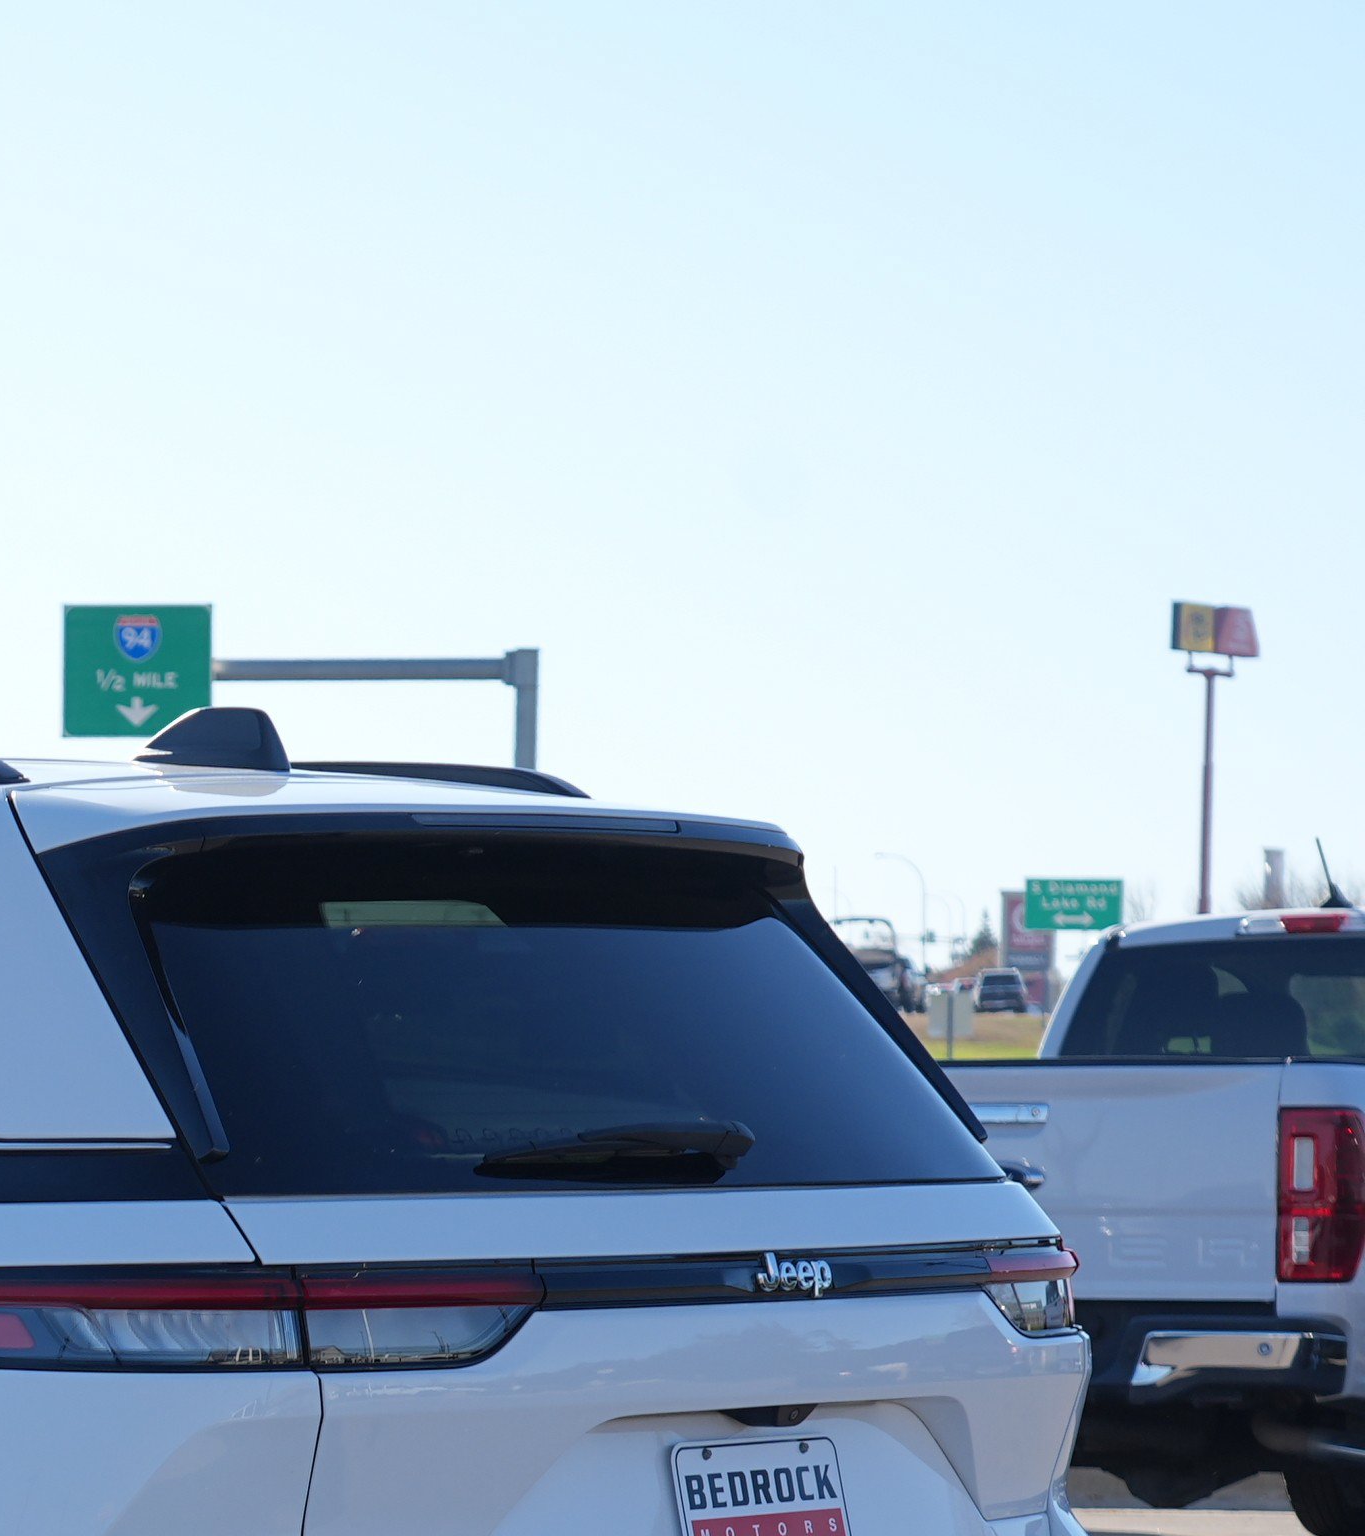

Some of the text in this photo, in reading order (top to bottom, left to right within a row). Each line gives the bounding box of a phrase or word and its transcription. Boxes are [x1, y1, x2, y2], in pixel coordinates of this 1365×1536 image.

[121, 626, 152, 650] 94
[132, 671, 178, 690] MILE
[1031, 880, 1118, 895] S Diamond
[1041, 896, 1108, 910] Lake Rd
[756, 1251, 834, 1298] Jeep
[684, 1464, 837, 1510] BEDROCK
